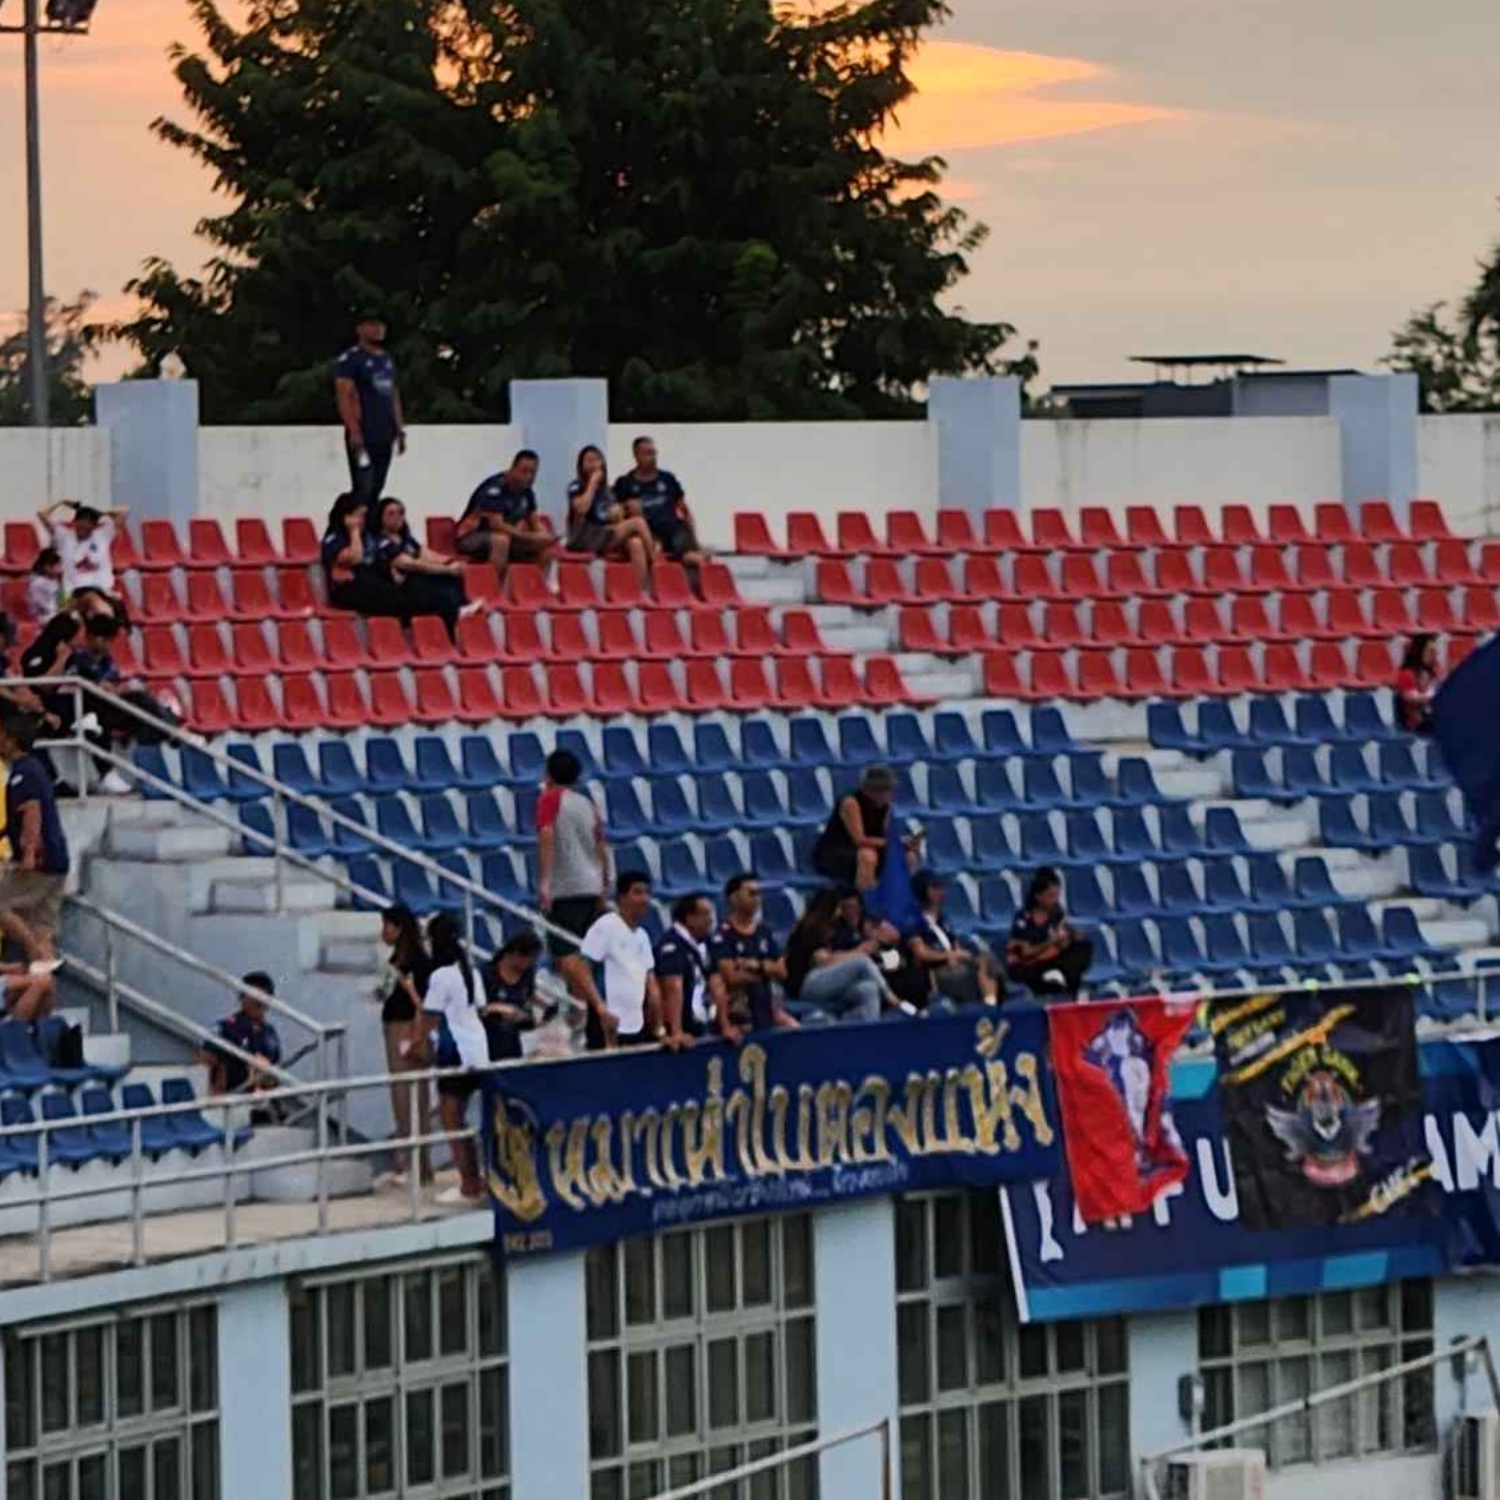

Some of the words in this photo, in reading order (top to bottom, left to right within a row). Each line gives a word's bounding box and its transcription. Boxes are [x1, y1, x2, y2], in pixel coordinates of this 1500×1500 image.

[545, 1017, 1055, 1211] หมาเห่าใบตองแห้ง
